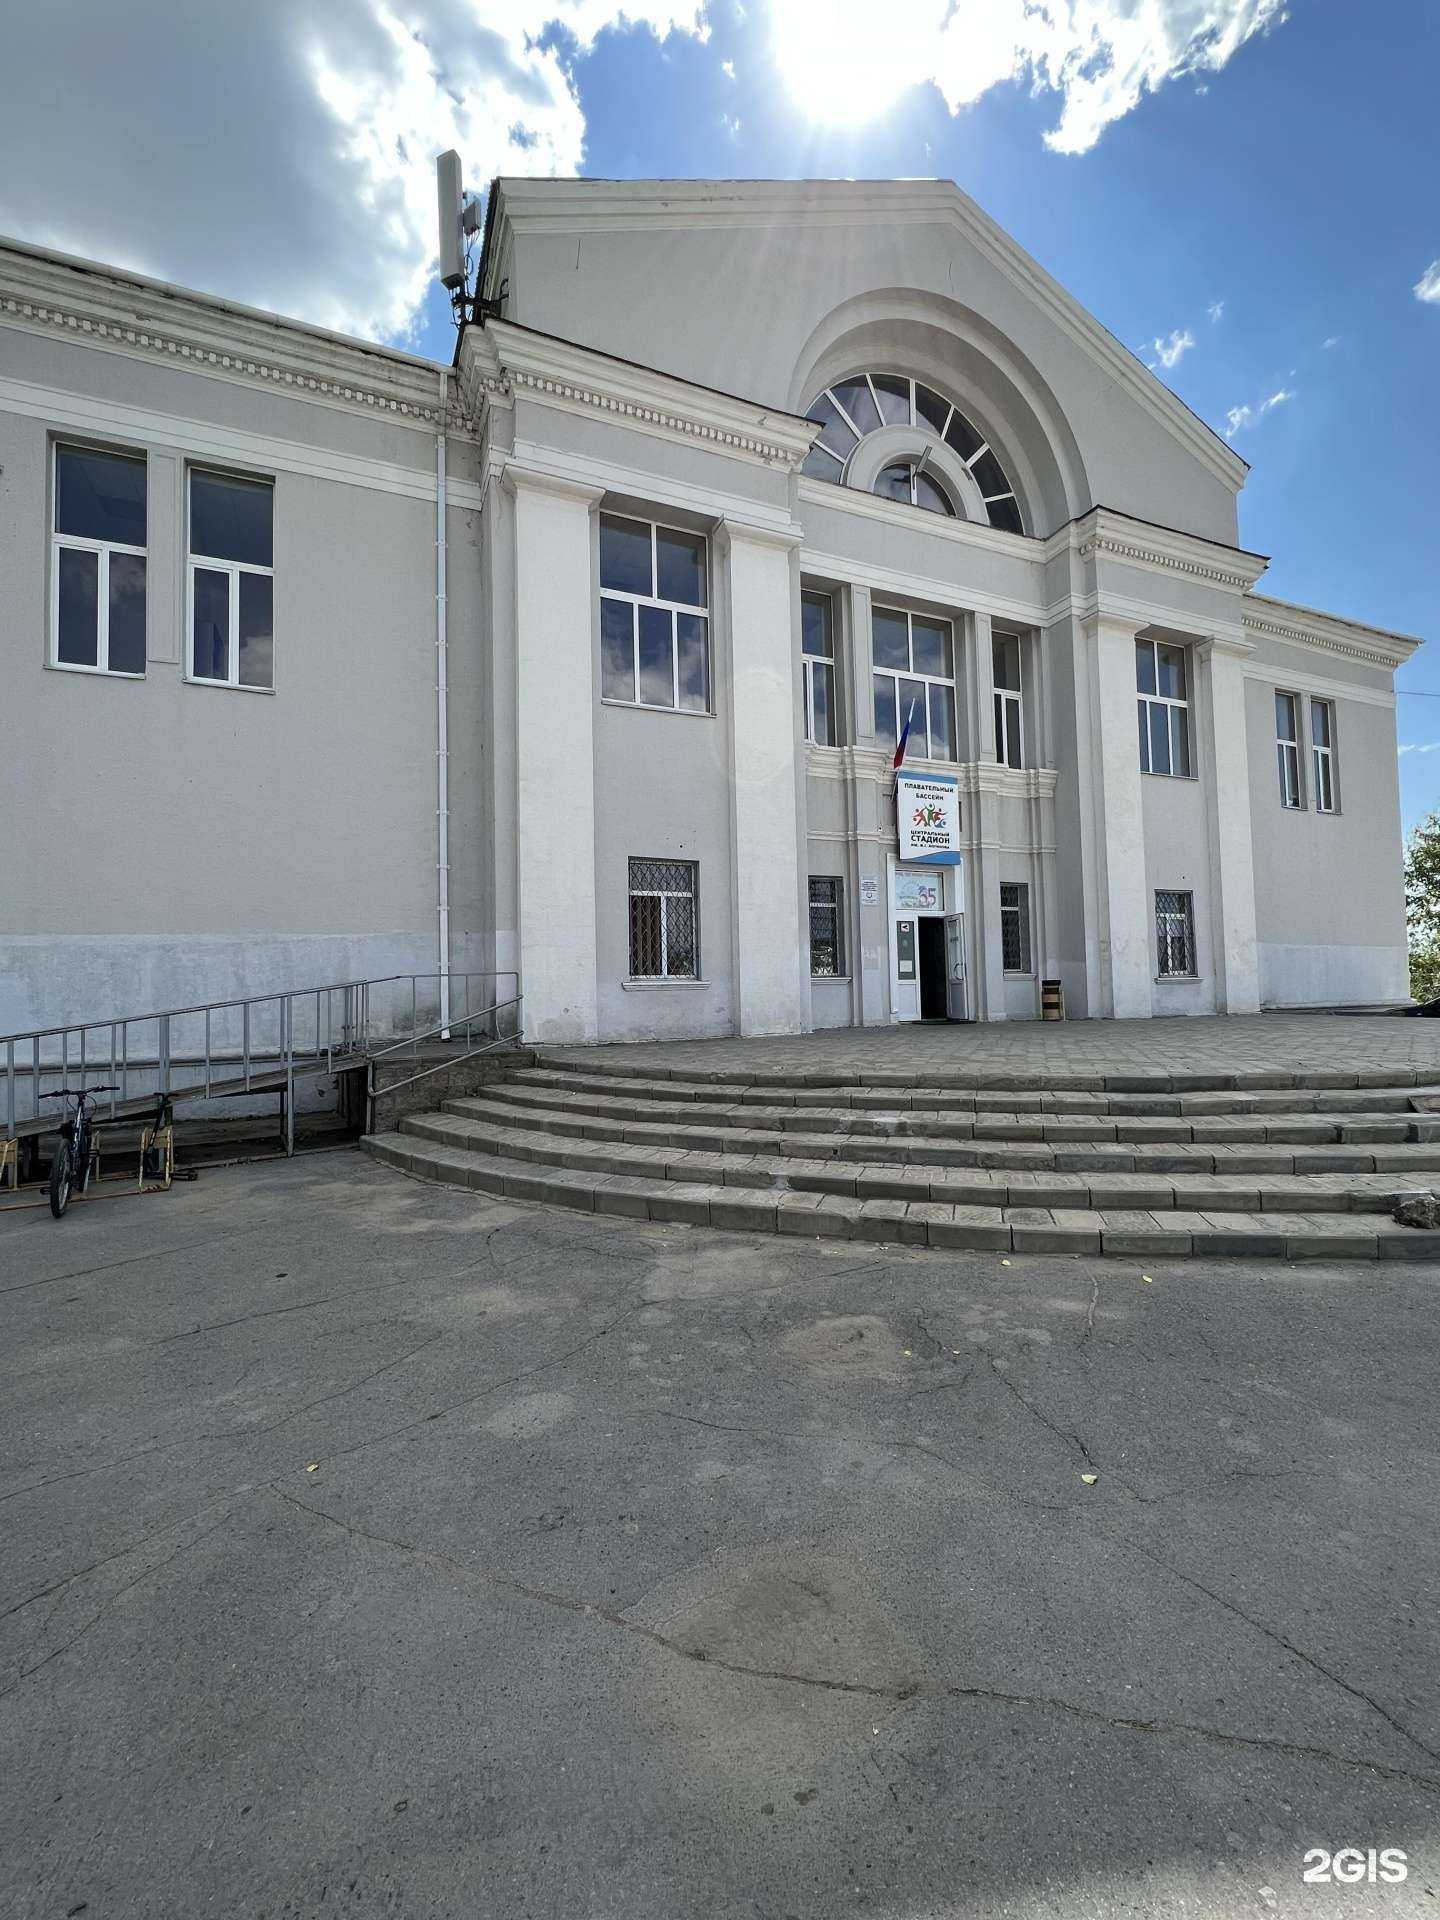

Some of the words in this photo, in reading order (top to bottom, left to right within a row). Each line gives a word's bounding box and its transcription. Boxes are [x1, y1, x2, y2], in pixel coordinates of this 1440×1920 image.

[904, 783, 954, 793] ПЛАВАТЕЛЬНЫЙ
[915, 793, 944, 801] БАССЕЙН
[910, 834, 950, 844] СТАДИОН
